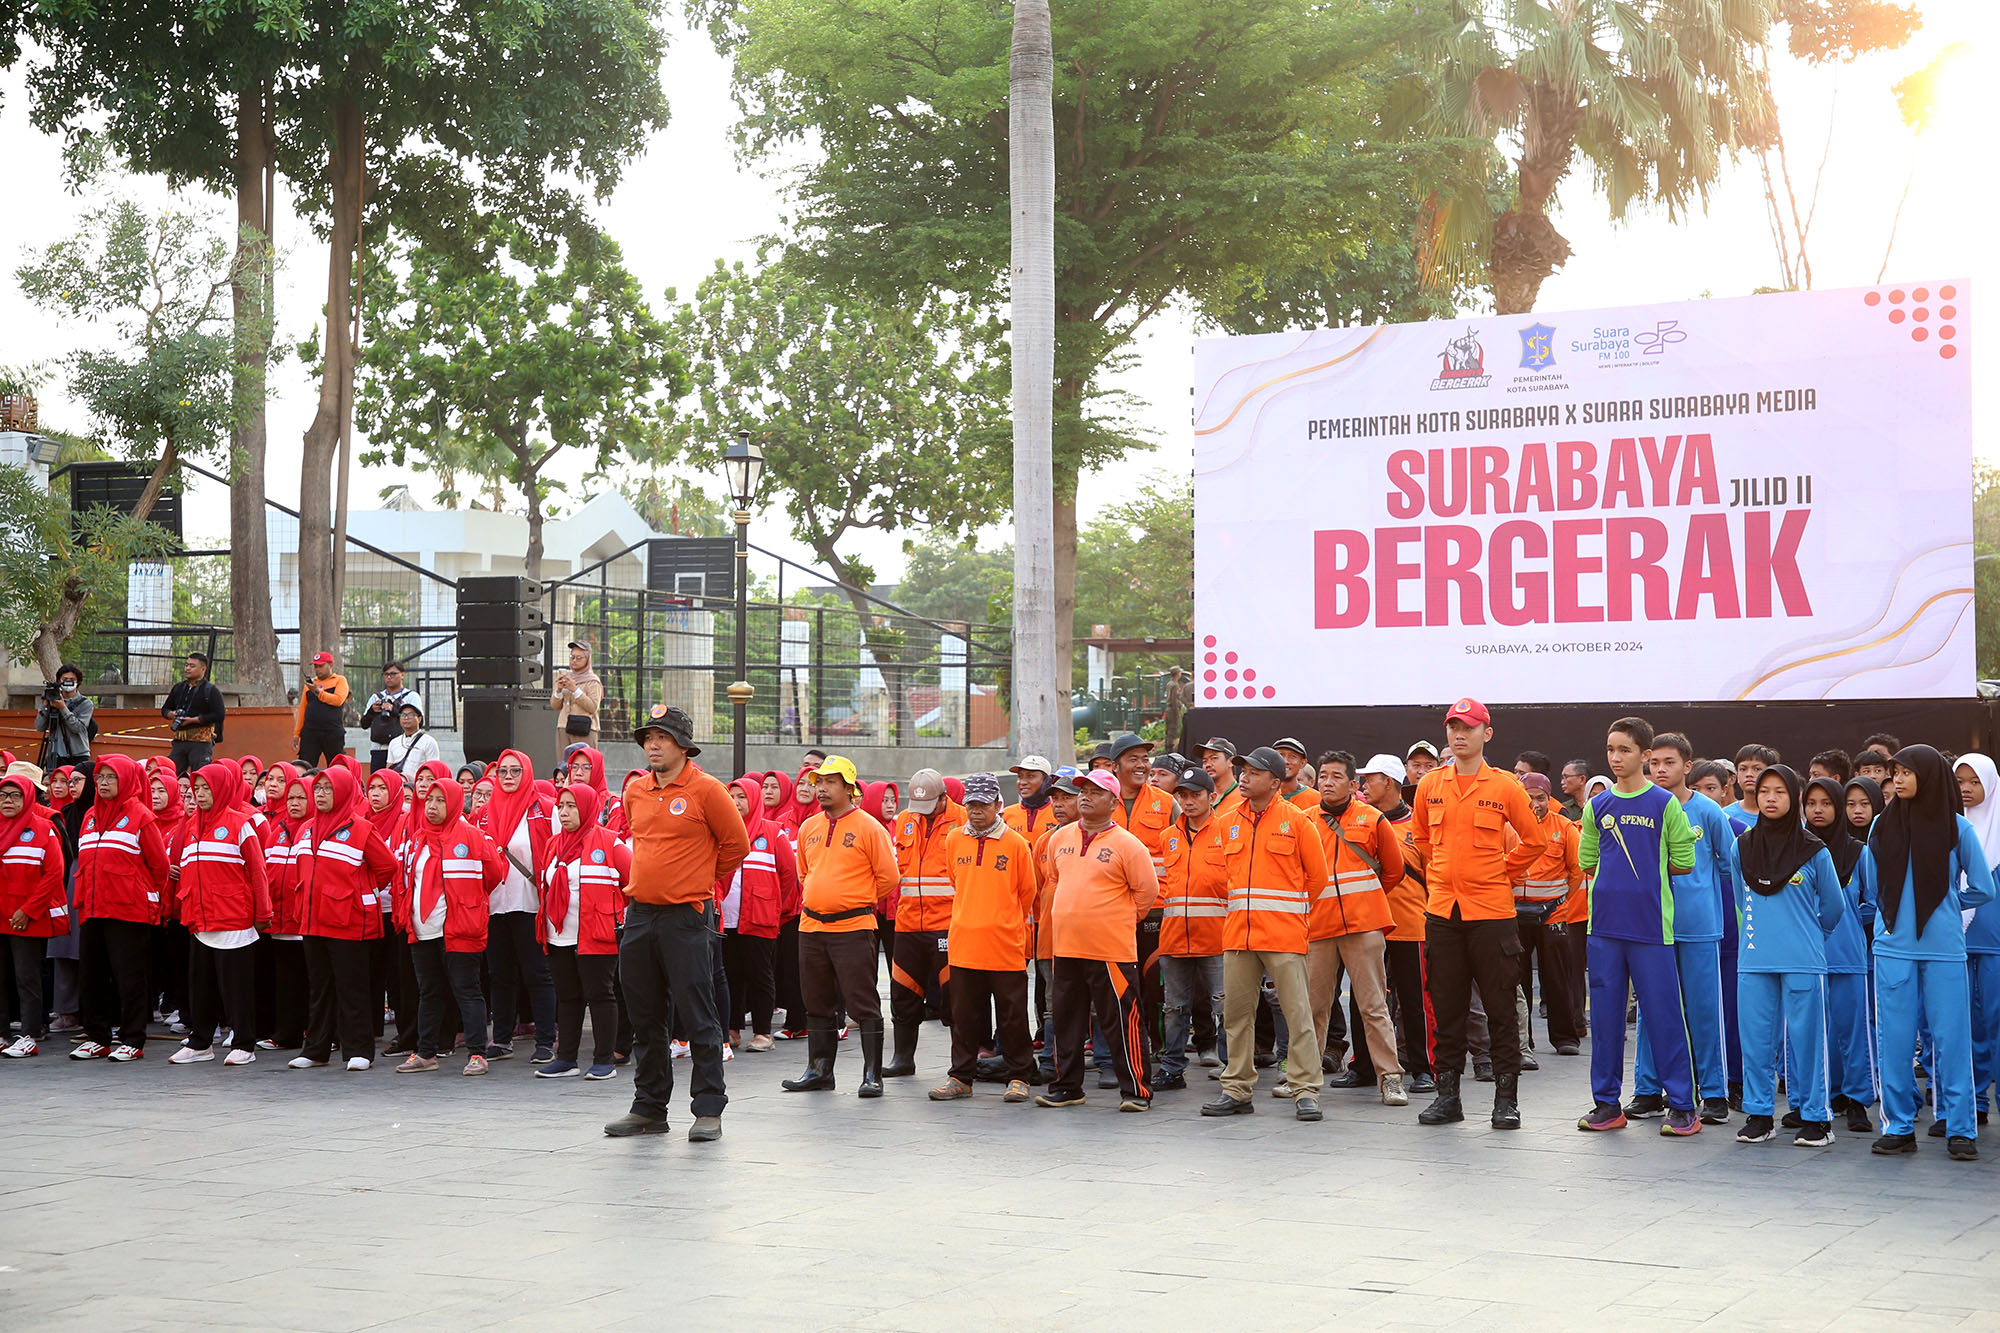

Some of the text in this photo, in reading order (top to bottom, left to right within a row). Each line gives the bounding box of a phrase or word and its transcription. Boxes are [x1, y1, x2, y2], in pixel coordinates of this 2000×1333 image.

[1593, 327, 1630, 339] Suara
[1571, 338, 1630, 353] Surabaya
[1598, 350, 1630, 360] FM 100
[1430, 375, 1492, 391] BERGERAK
[1513, 374, 1562, 383] PEMERINTAH
[1507, 383, 1570, 394] KOTA SURABAYA
[1308, 388, 1816, 440] PEMERINTAH KOTA SURABAYA X SUARA SURABAYA MEDIA
[1386, 433, 1813, 519] SURABAYA JILID II
[1314, 509, 1814, 629] BERGERAK
[1465, 641, 1643, 655] SURABAYA, 24 OKTOBER 2024
[1478, 799, 1504, 811] BPBD
[1620, 814, 1655, 829] SPENMA
